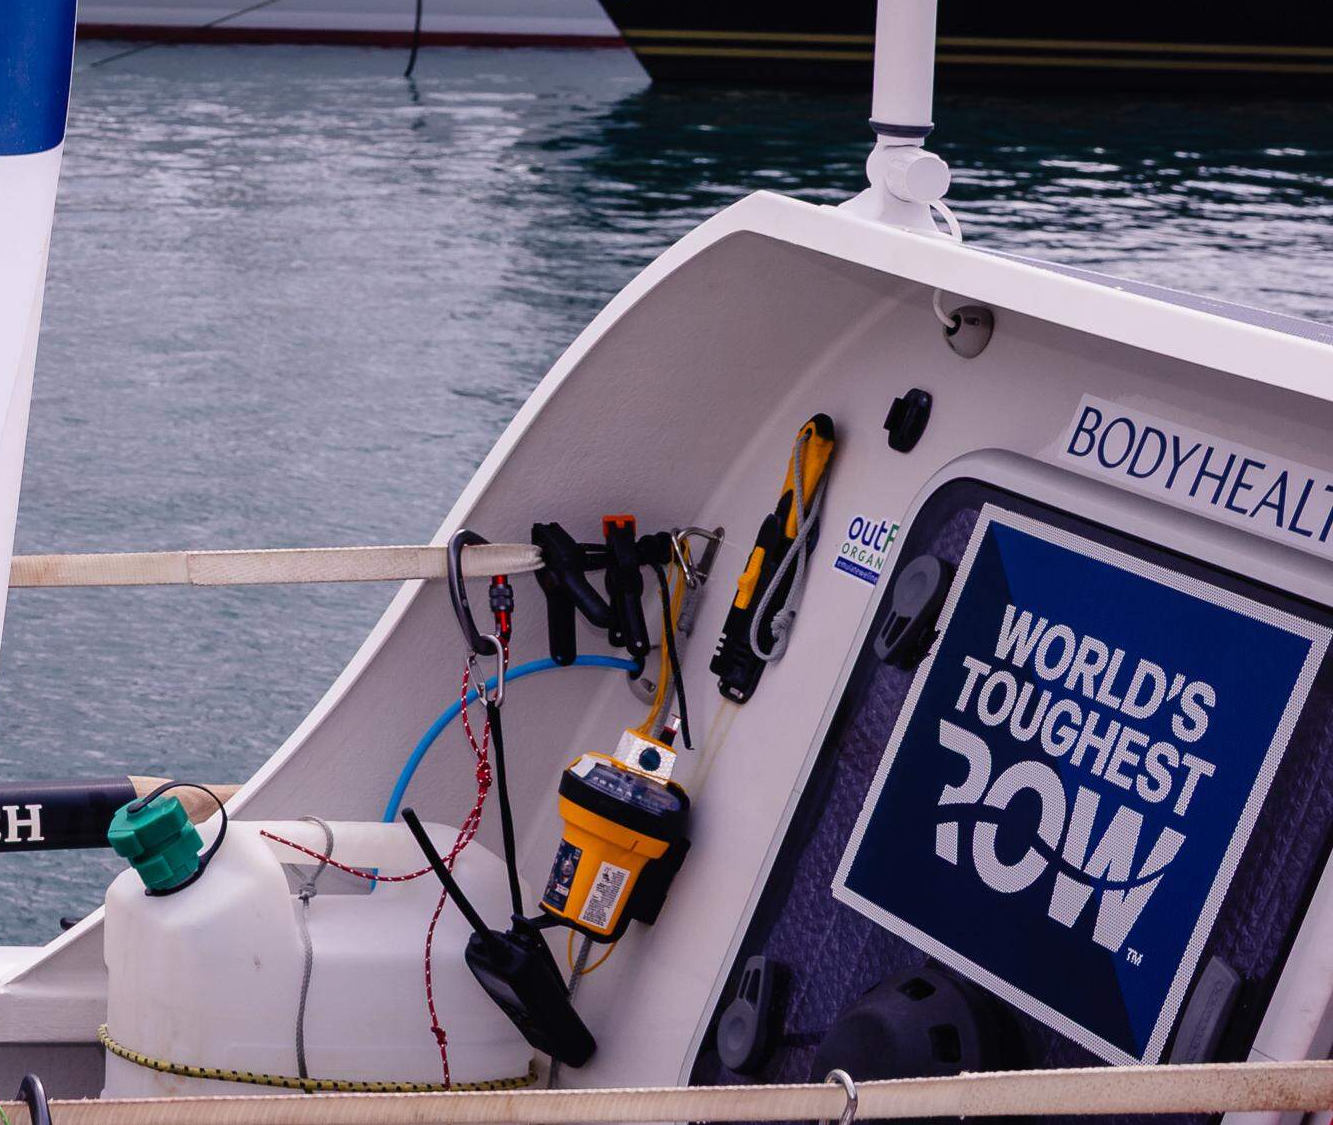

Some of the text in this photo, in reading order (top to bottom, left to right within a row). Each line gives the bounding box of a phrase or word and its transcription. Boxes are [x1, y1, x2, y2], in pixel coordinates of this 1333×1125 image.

[955, 655, 1216, 816] TOUGHEST
[994, 604, 1216, 743] WORLD'S
[935, 719, 1186, 953] ROW
